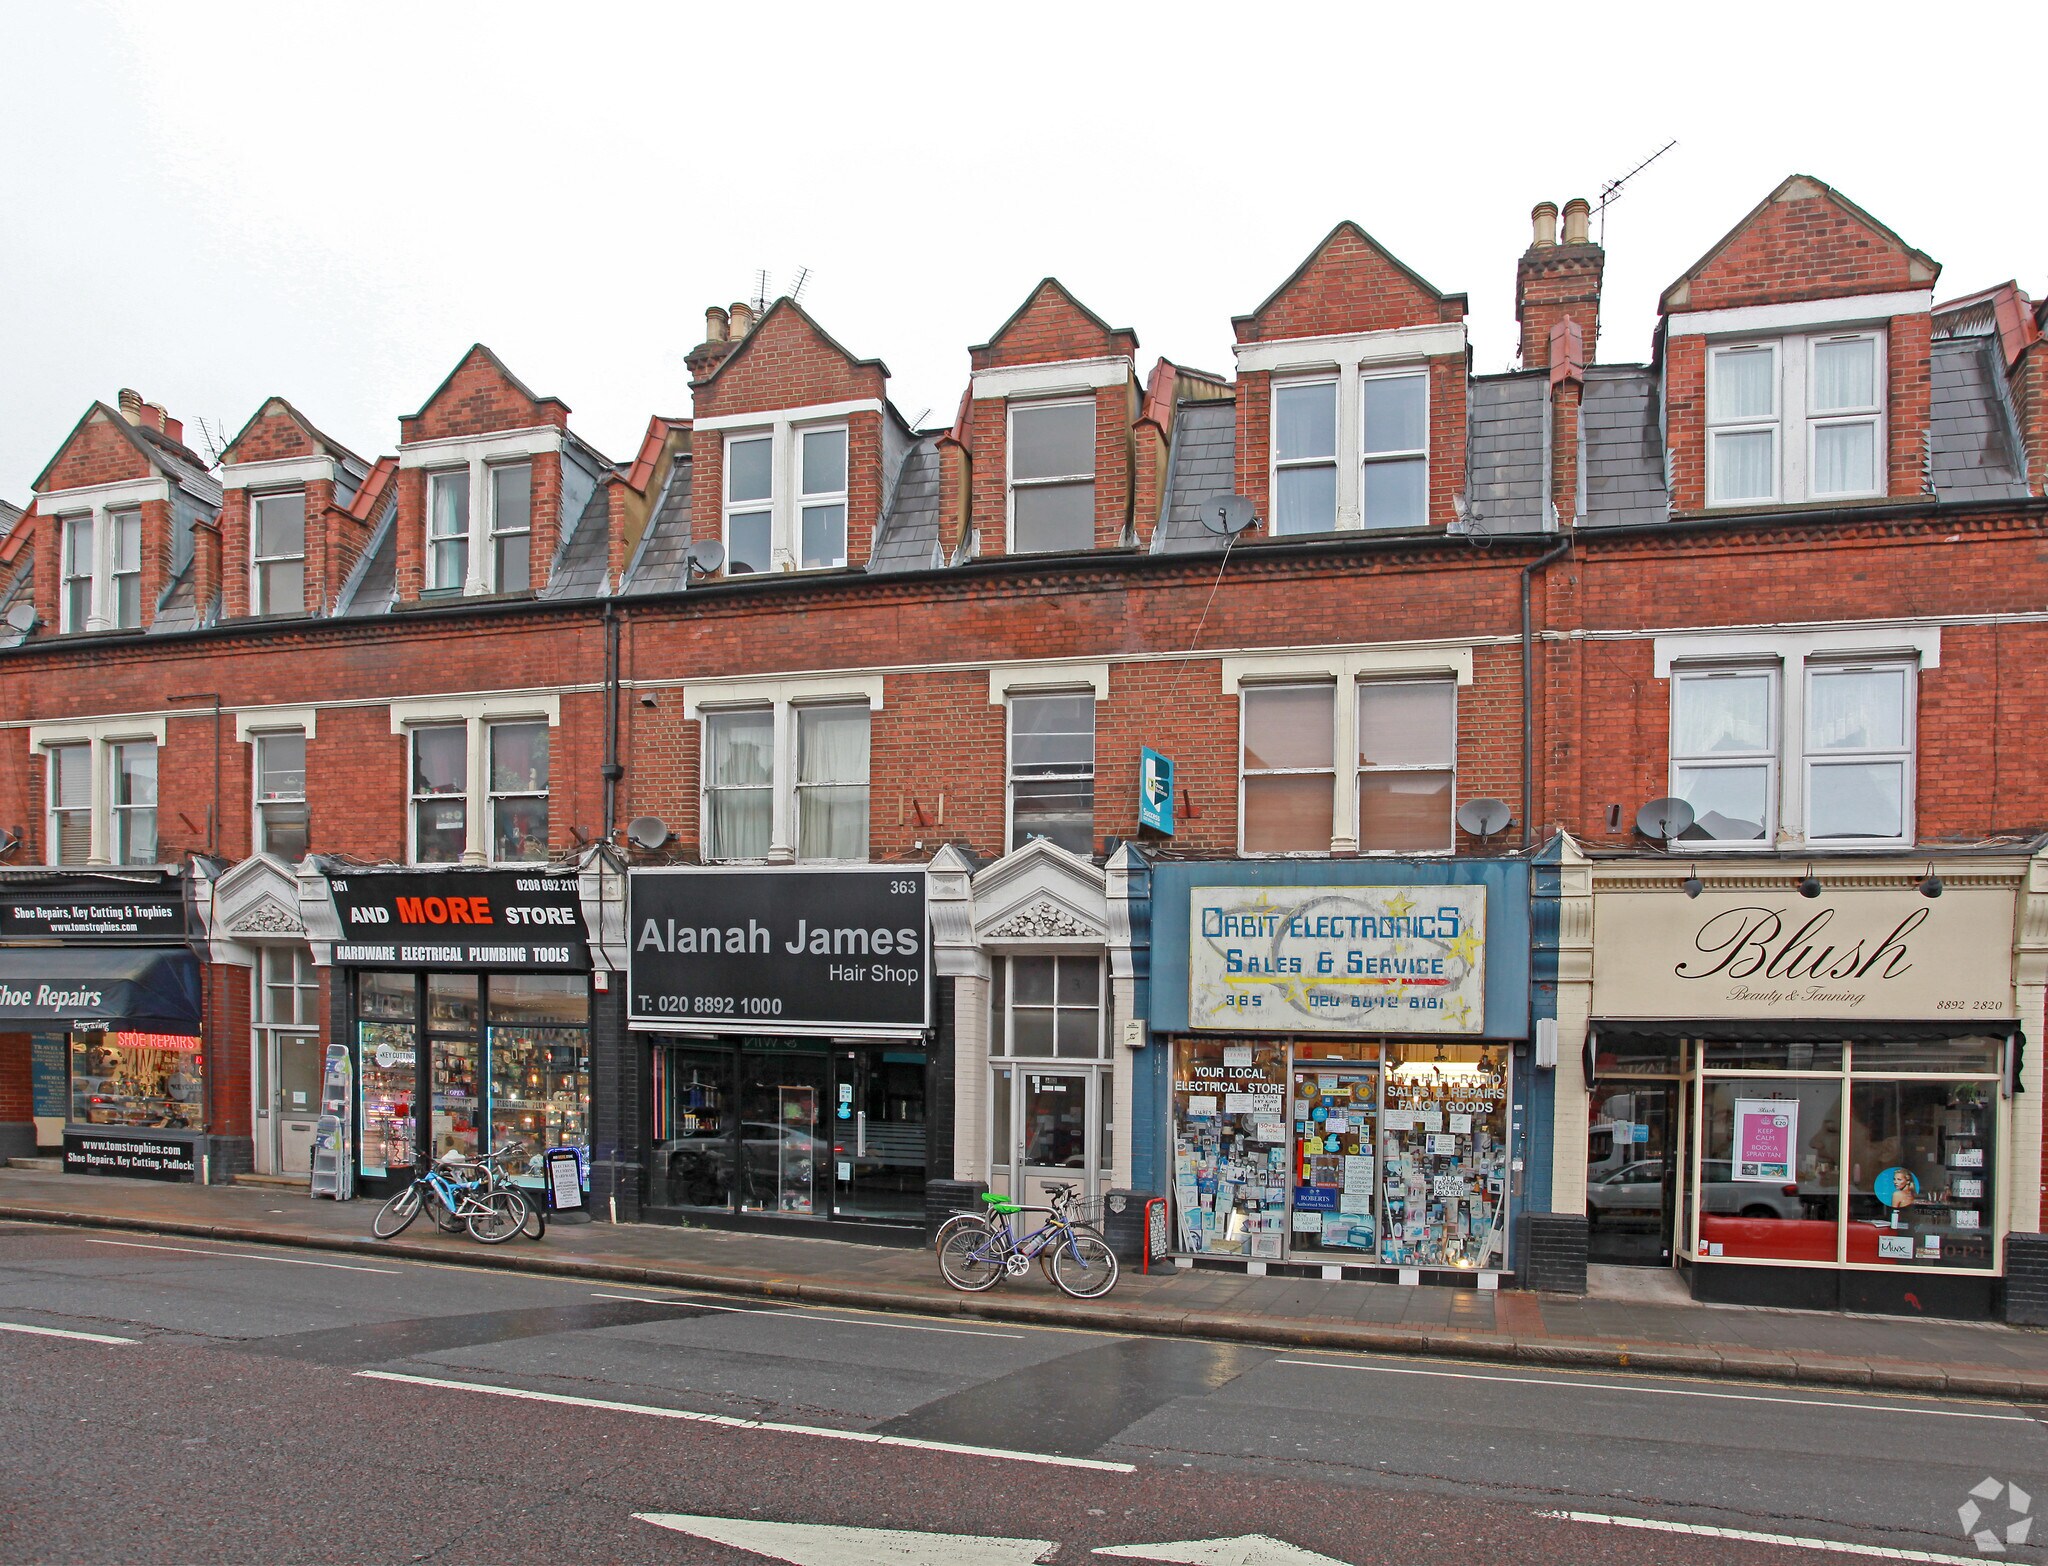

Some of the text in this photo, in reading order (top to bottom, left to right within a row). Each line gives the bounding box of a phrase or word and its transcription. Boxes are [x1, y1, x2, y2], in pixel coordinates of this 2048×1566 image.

[332, 880, 580, 892] 361 0208 892 2111
[890, 880, 917, 894] 363
[14, 906, 172, 920] Shoe Repairs, Key Cutting & Trophies
[350, 896, 576, 924] AND MORE STORE
[50, 922, 138, 933] www.tomstrophies.com
[1202, 906, 1460, 938] ORBIT ELECTRONICS
[636, 918, 918, 956] Alanah James
[1674, 907, 1930, 980] Blush
[336, 946, 570, 962] HARDWARE ELECTRICAL PLUMBING TOOLS
[1317, 952, 1334, 974] &
[1346, 950, 1444, 974] SERVICE
[830, 964, 918, 986] Hair Shop
[36, 984, 102, 1012] Repairs
[1226, 995, 1262, 1006] 365
[1726, 984, 1866, 1007] Beauty & Tanning
[638, 995, 782, 1015] T: 020 8892 1000
[1936, 1000, 2003, 1011] 8892 2820
[74, 1020, 110, 1032] Engraving
[118, 1032, 195, 1049] SHOE REPAIRS
[392, 1052, 414, 1060] CUTTING
[1194, 1066, 1266, 1079] YOUR LOCAL
[1460, 1074, 1501, 1084] RADIO
[1175, 1081, 1286, 1094] ELECTRICAL STORE
[1388, 1086, 1505, 1099] SALES & REPAIRS
[1398, 1100, 1494, 1113] FANCY GOODS
[82, 1140, 181, 1155] www.tomstrophies.com
[68, 1152, 86, 1163] Shoe
[86, 1154, 116, 1166] Repairs,
[118, 1156, 130, 1167] Key
[132, 1156, 162, 1170] Cutting,
